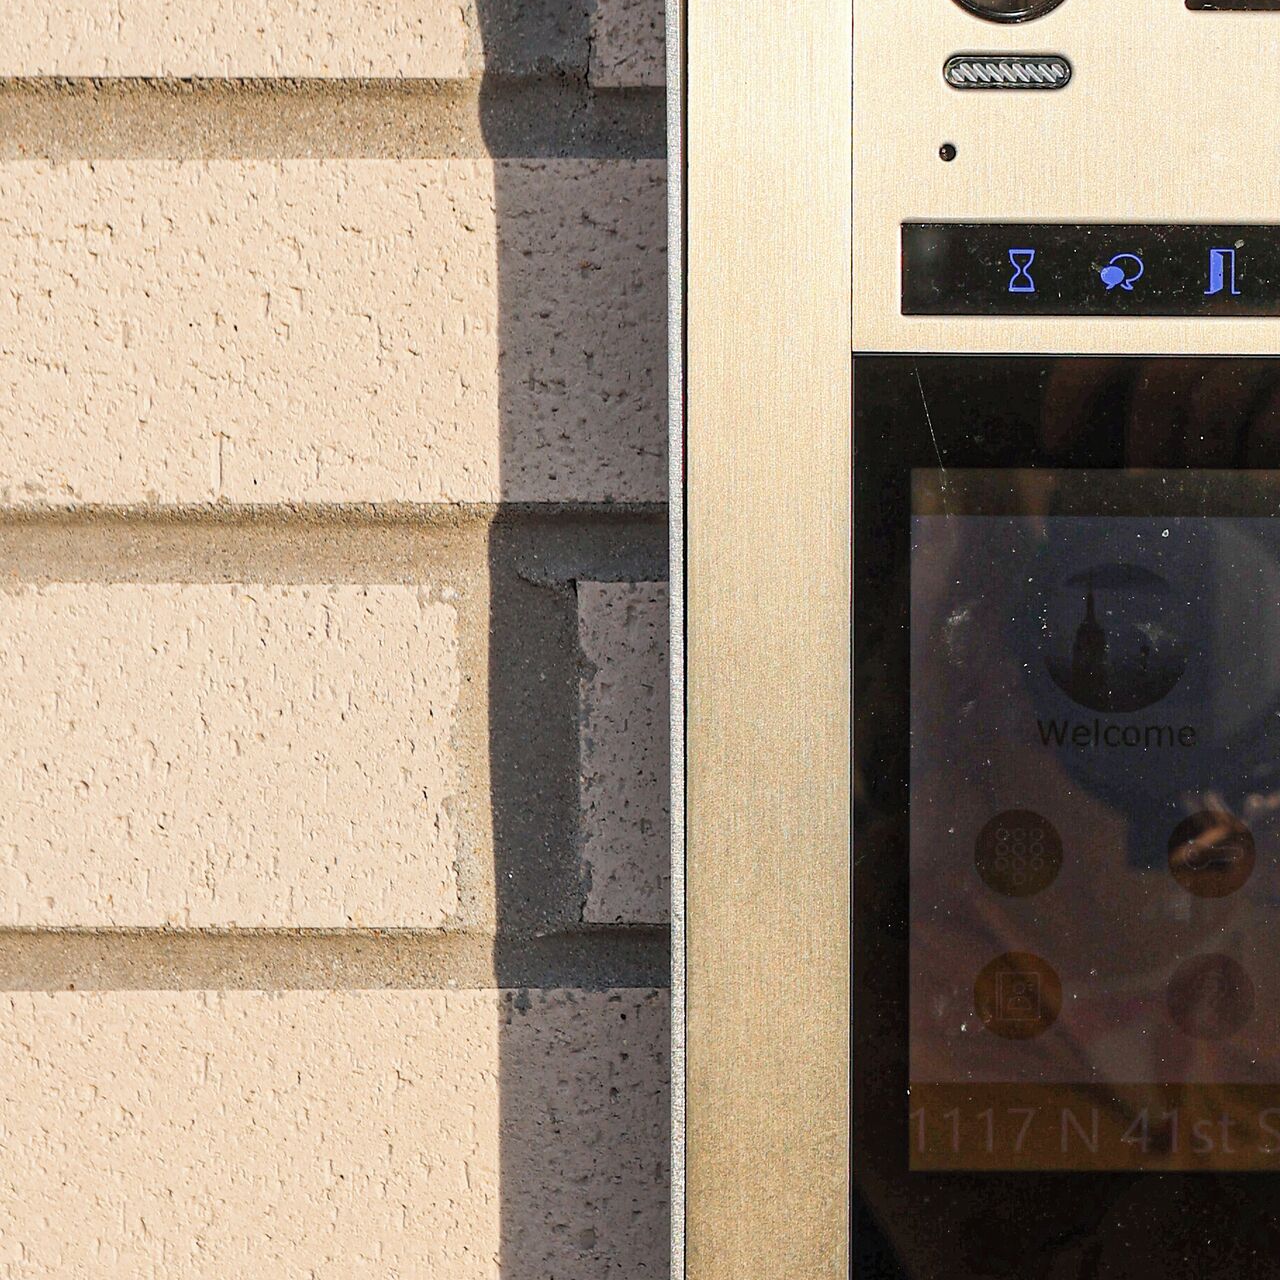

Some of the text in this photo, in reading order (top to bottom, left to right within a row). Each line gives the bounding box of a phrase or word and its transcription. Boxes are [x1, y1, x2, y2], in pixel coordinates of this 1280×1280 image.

[1037, 718, 1197, 748] Welcome
[910, 1107, 1036, 1153] 1117
[1061, 1108, 1099, 1153] N
[1121, 1107, 1237, 1154] 41st
